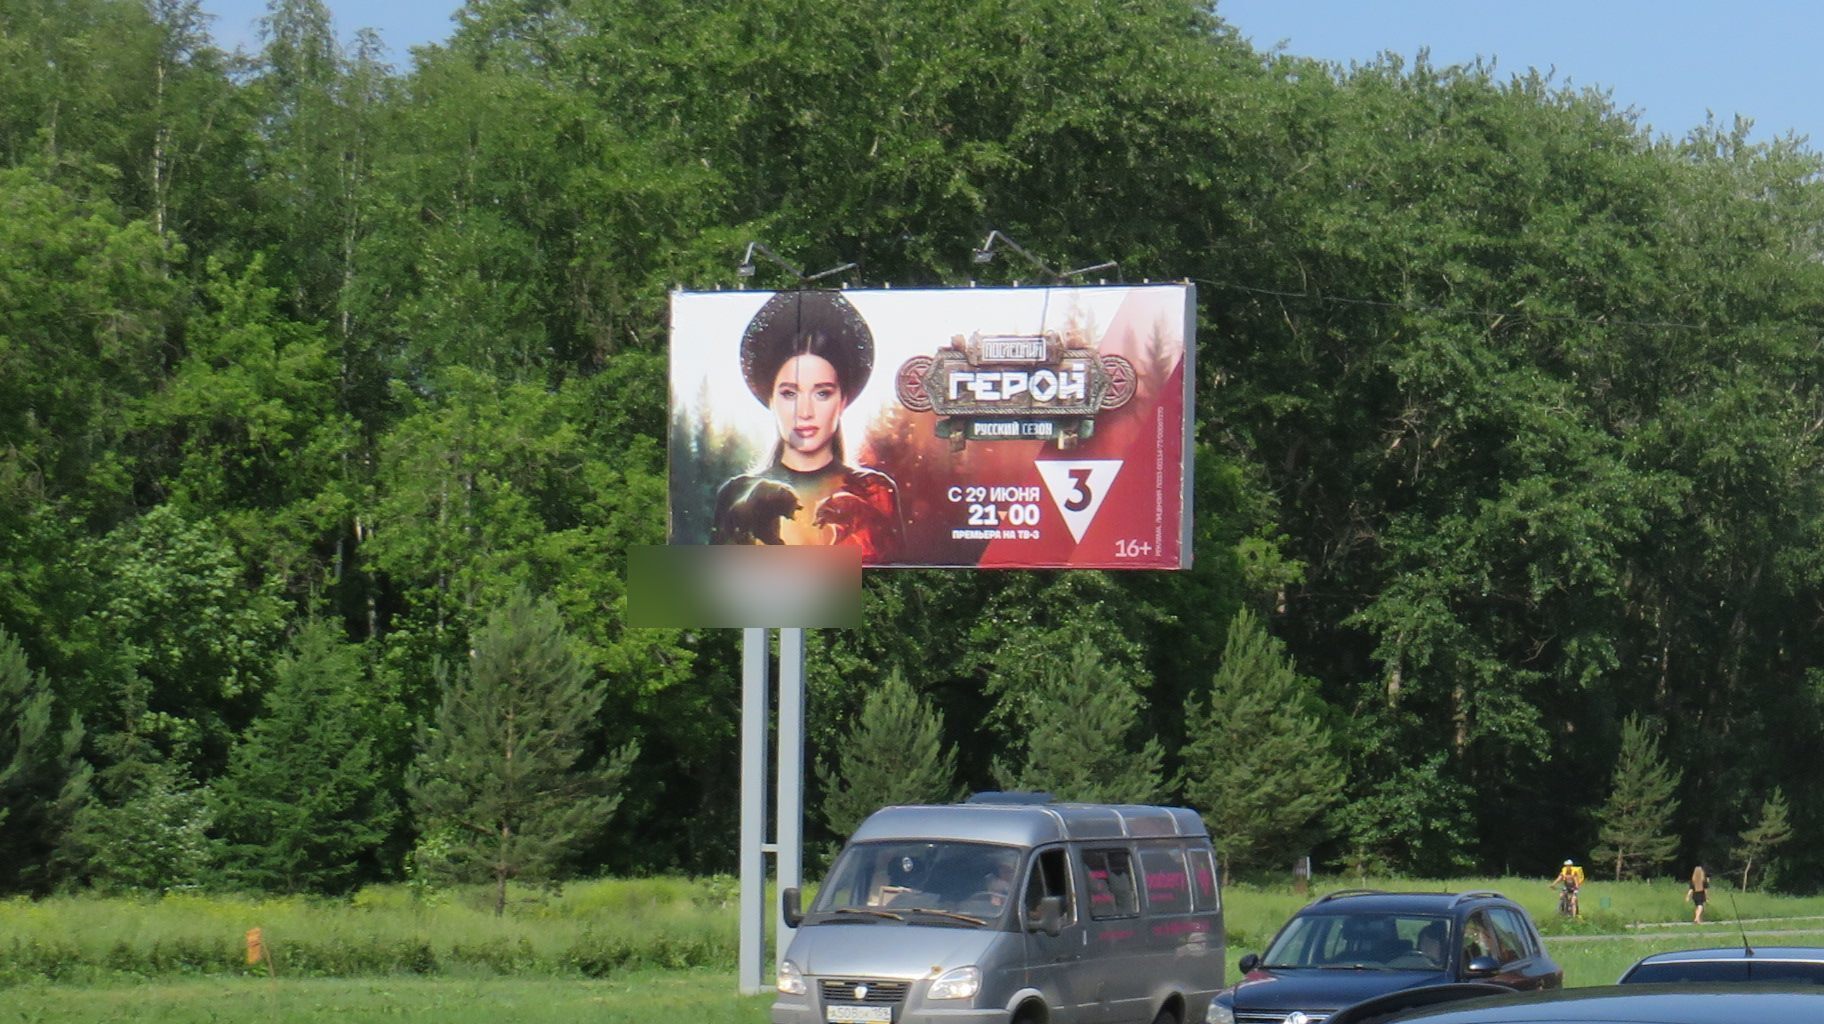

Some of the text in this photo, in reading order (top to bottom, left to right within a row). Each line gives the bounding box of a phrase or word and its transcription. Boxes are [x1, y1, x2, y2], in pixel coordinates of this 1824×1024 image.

[949, 363, 1086, 402] ГЕРОЙ
[974, 420, 1053, 436] РУССКИЙ СЕЗОН
[948, 486, 1041, 502] С 29 ИЮНЯ
[1063, 468, 1094, 512] 3
[952, 529, 1041, 540] ПРЕМЬЕРА НА ТВ-3
[1114, 538, 1153, 558] 16+
